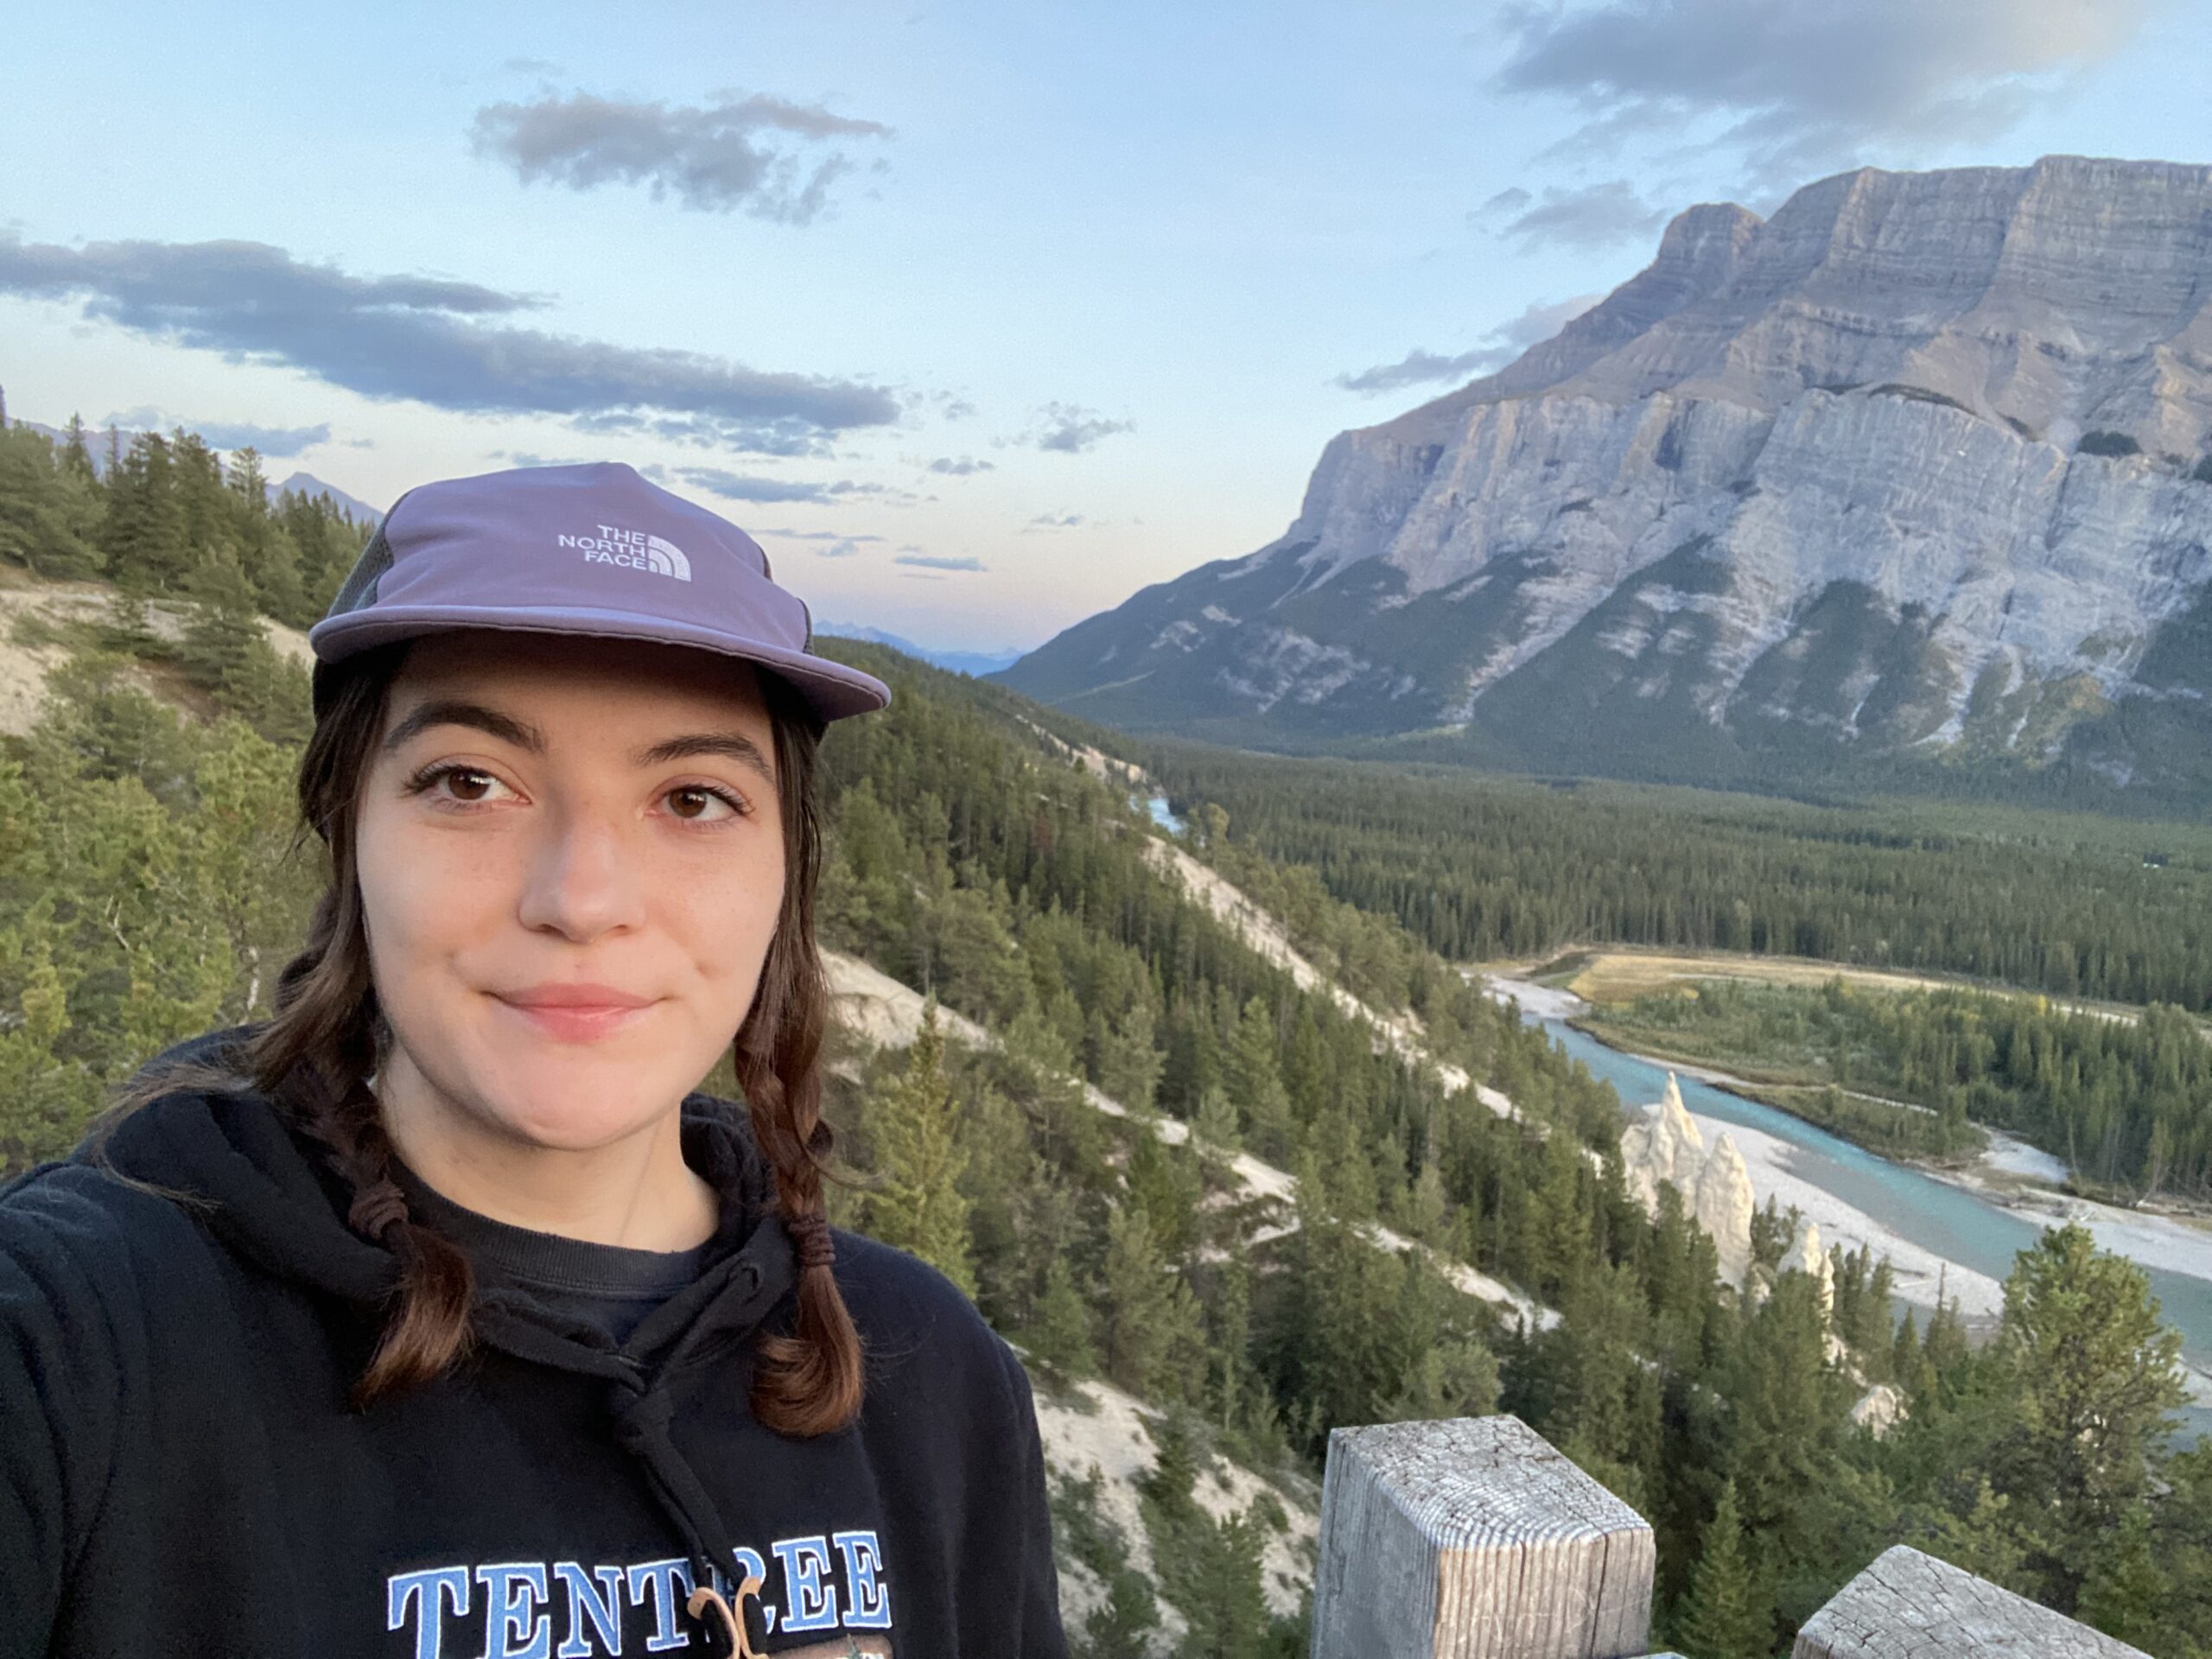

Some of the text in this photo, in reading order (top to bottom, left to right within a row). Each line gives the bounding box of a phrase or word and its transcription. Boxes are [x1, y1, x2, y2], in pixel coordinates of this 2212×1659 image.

[557, 534, 645, 556] NORTH
[597, 524, 645, 546] THE
[584, 550, 646, 570] FACE
